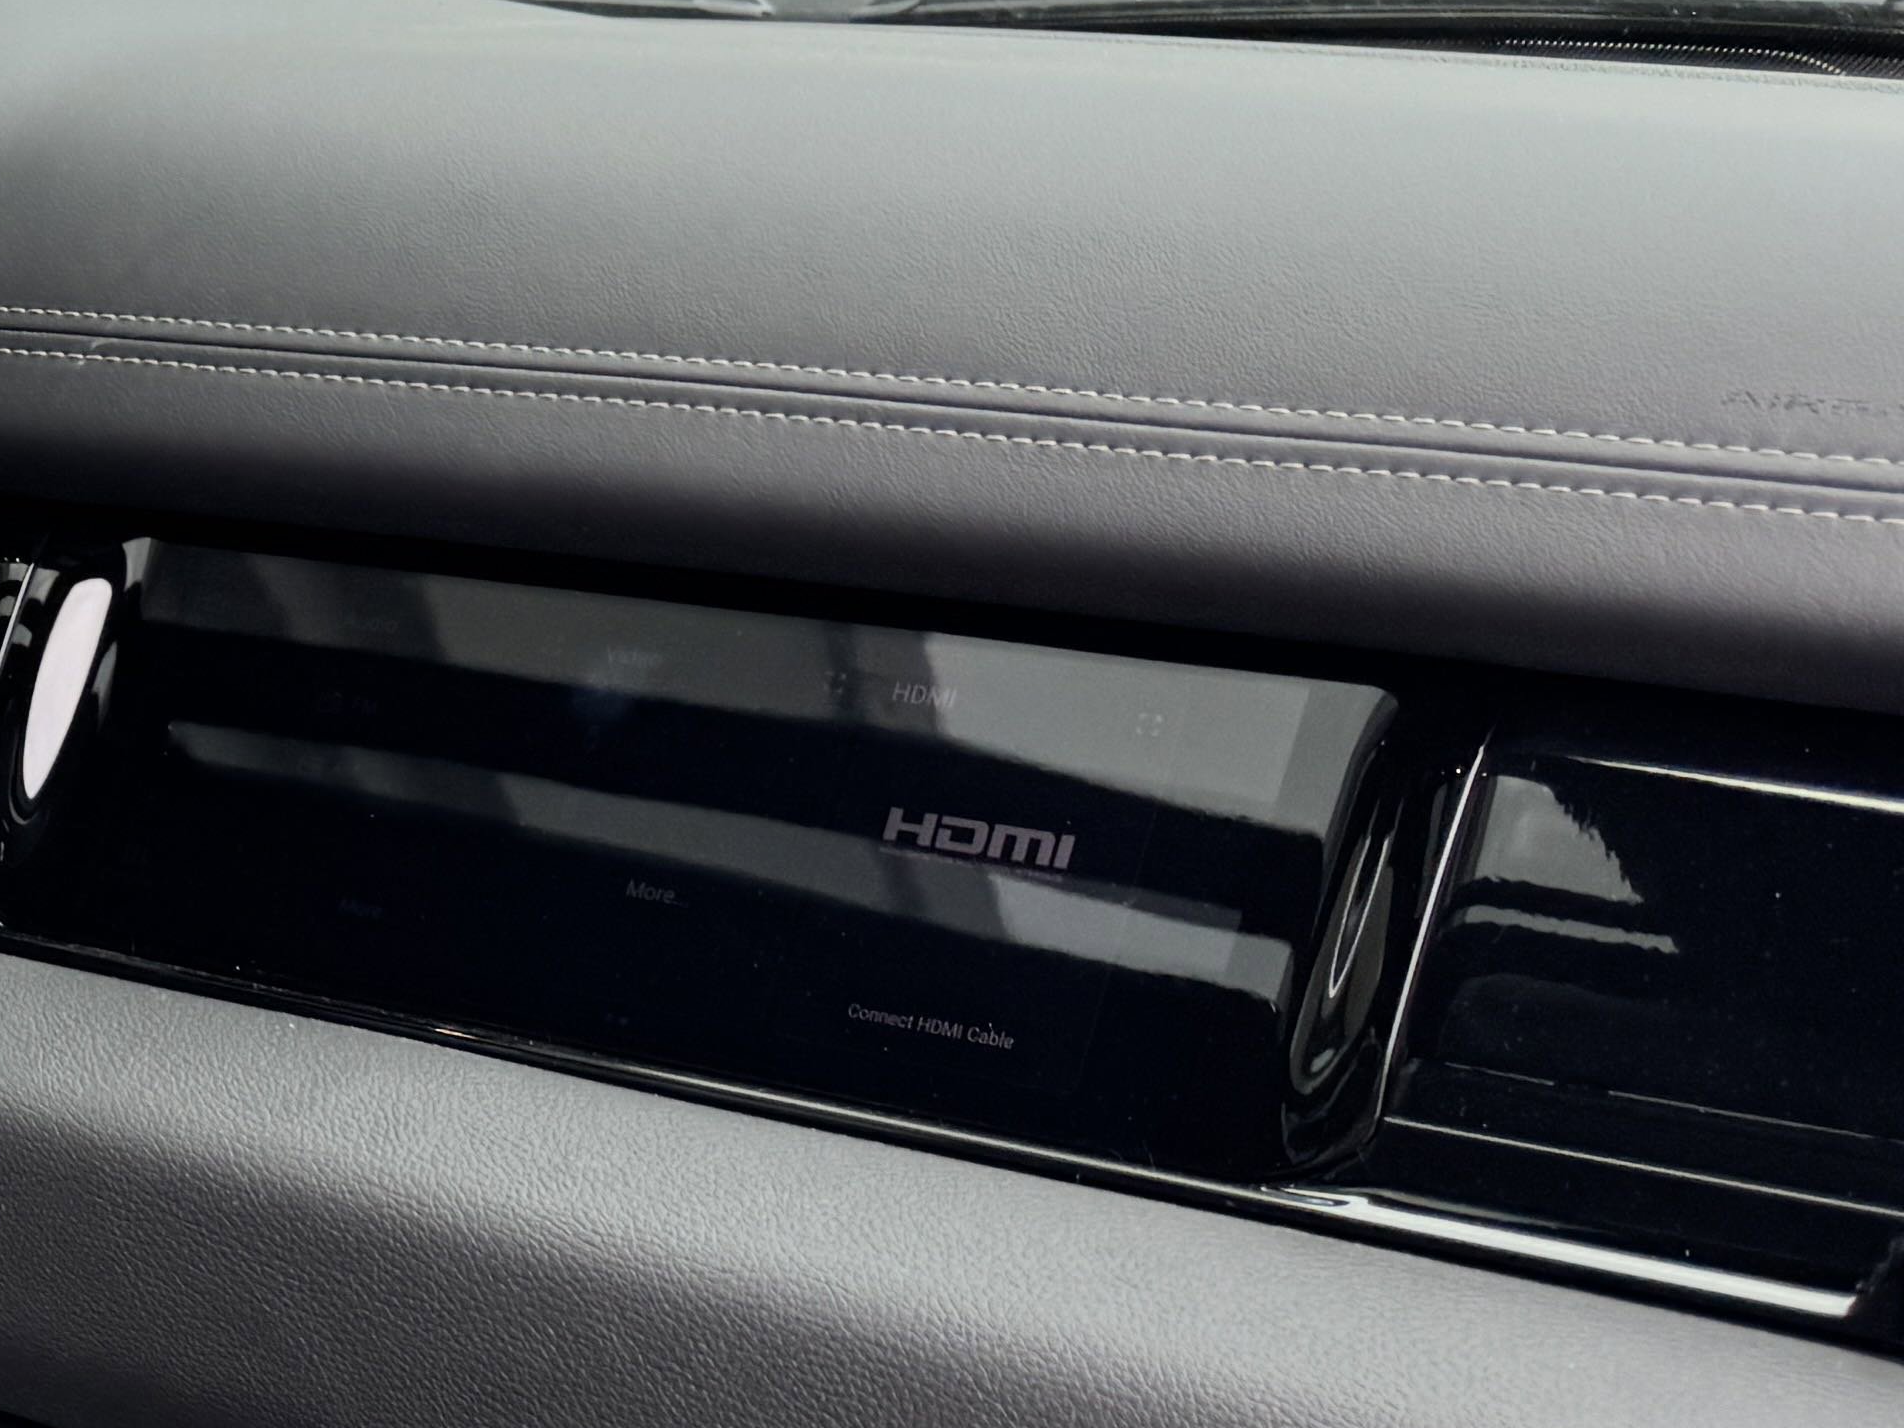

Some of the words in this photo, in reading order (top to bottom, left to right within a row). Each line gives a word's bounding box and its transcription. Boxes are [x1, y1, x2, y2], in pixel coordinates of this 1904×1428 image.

[892, 681, 959, 709] HDMI
[881, 805, 1077, 871] HDMI
[847, 1002, 914, 1031] Connect
[917, 1016, 964, 1042] HDMI
[967, 1024, 1015, 1051] Cable
